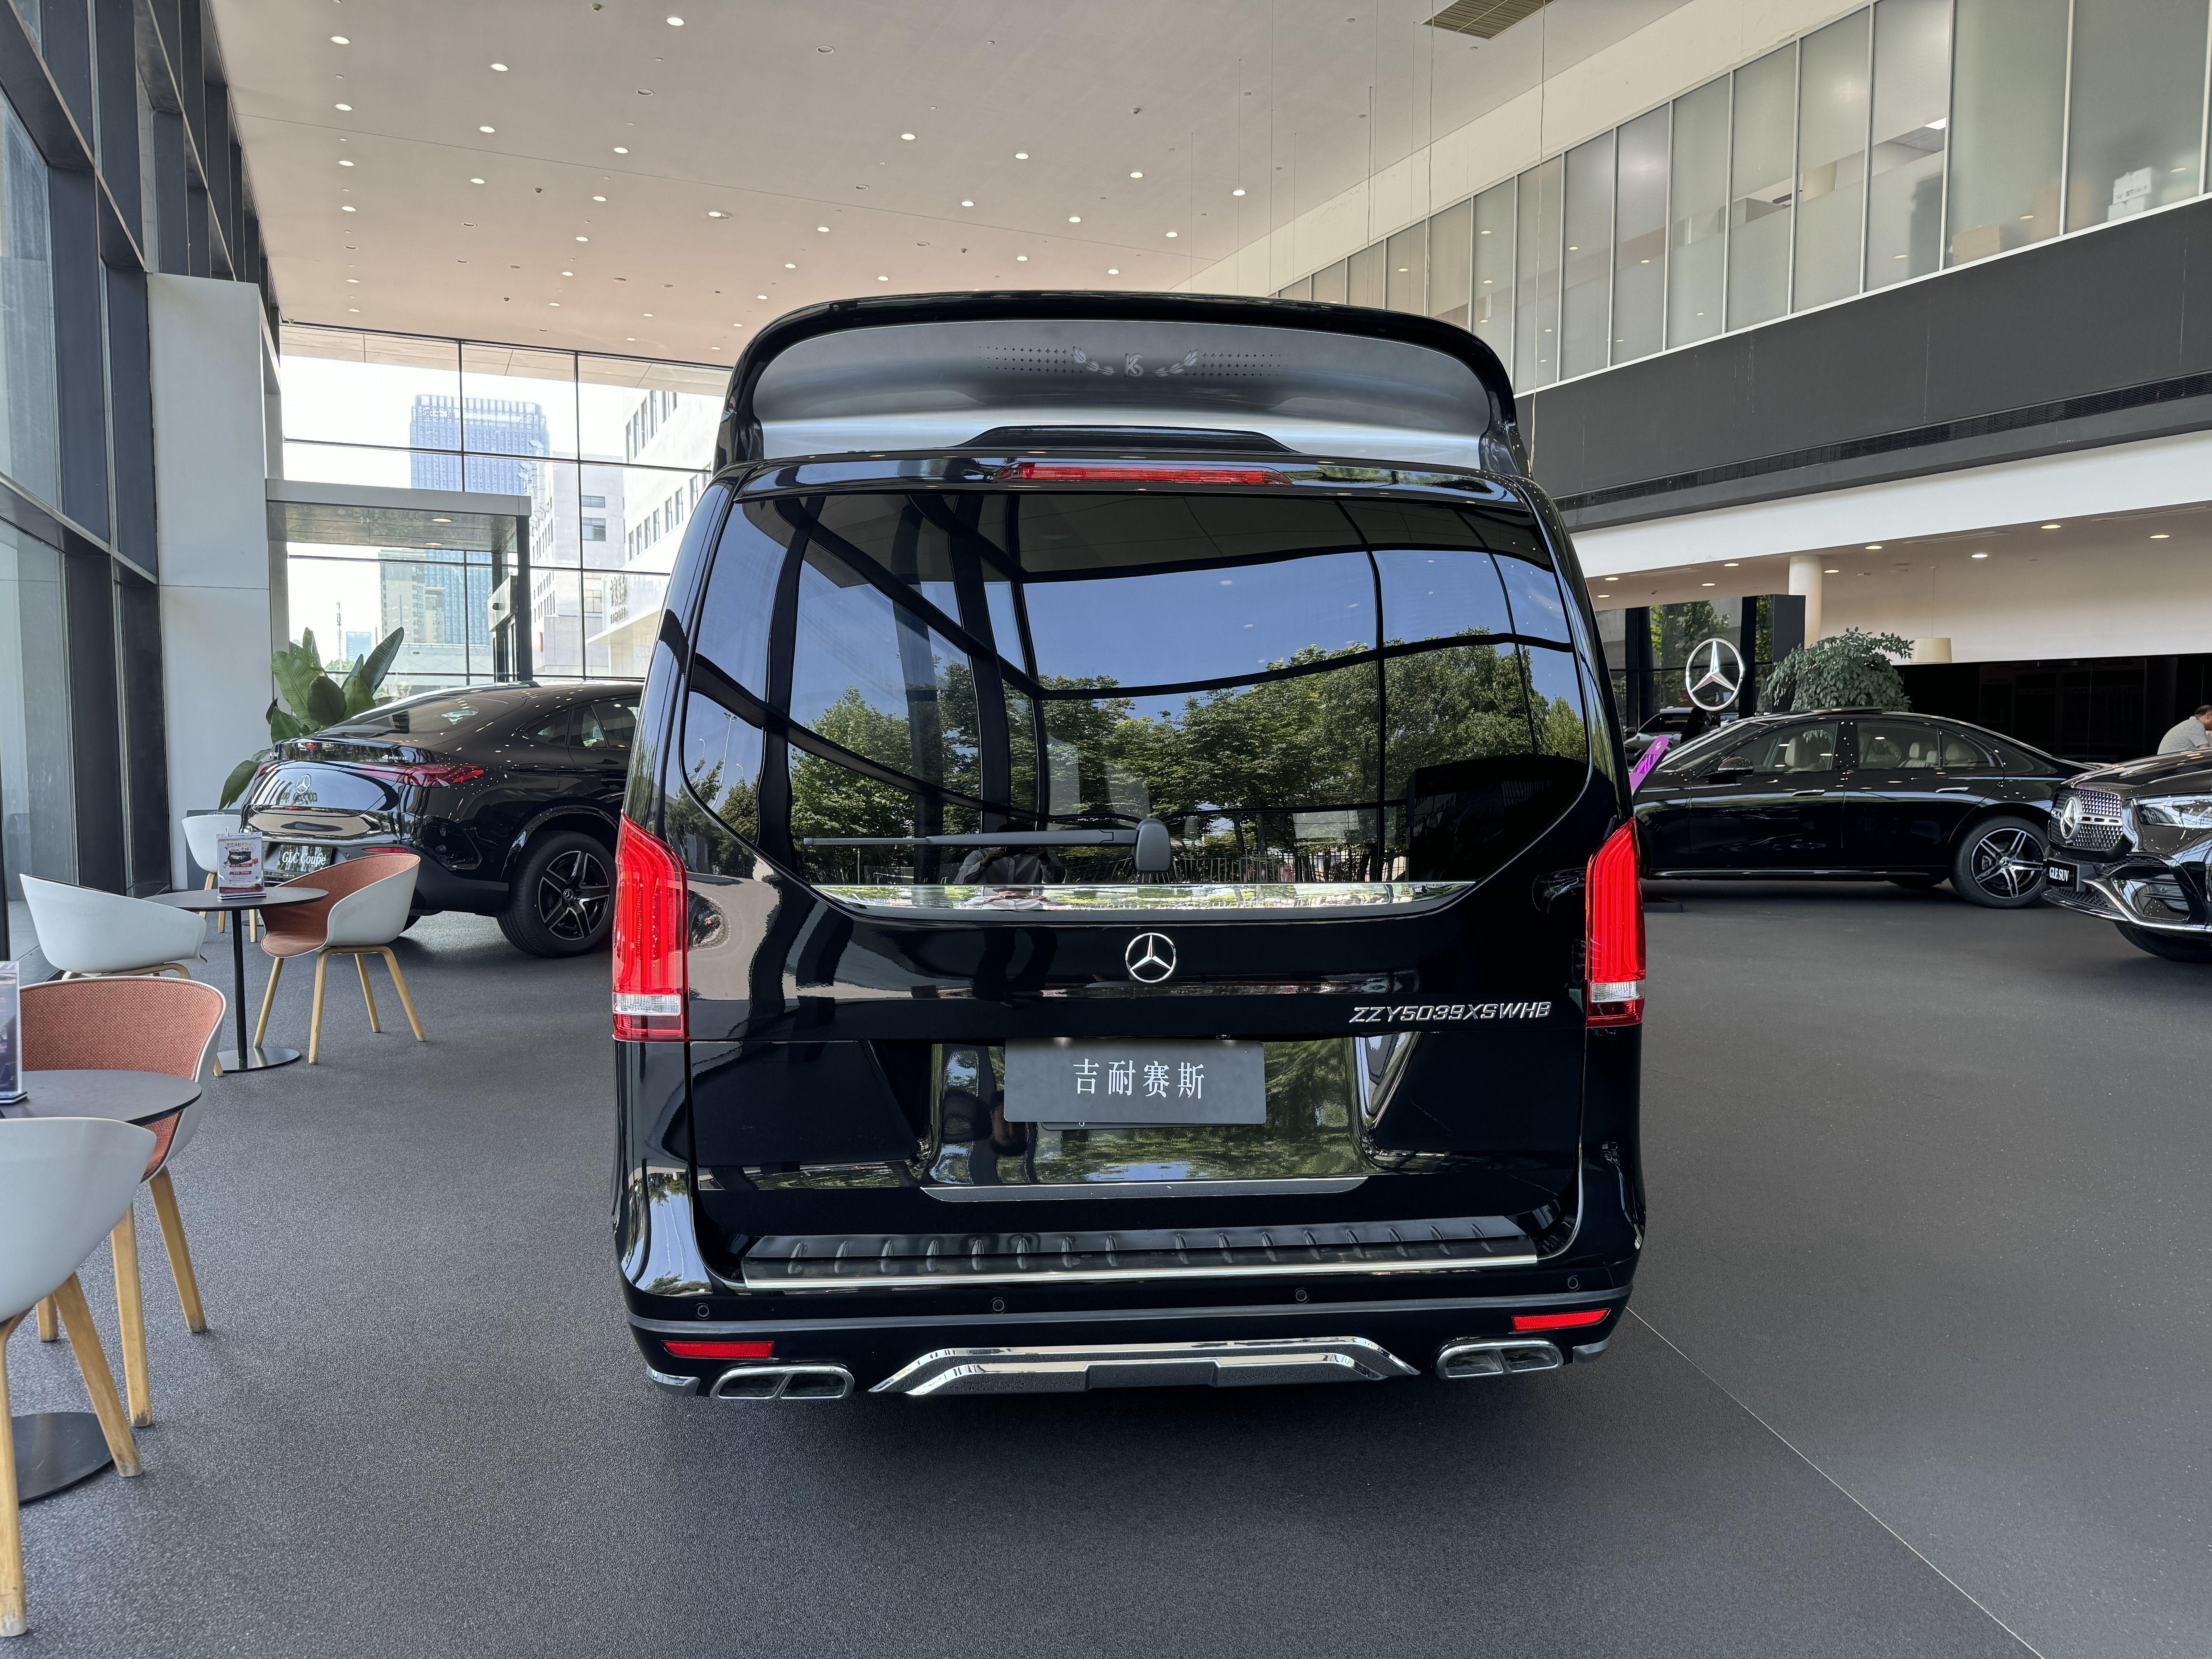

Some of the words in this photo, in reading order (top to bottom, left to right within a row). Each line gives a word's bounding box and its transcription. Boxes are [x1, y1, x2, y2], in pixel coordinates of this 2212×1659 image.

[282, 851, 300, 863] GLC
[300, 853, 326, 867] Coupe
[2049, 867, 2058, 879] GLE
[2058, 869, 2069, 881] SUV
[1349, 1001, 1551, 1023] ZZY5039XSWHB
[1073, 1058, 1205, 1099] 吉耐赛斯
